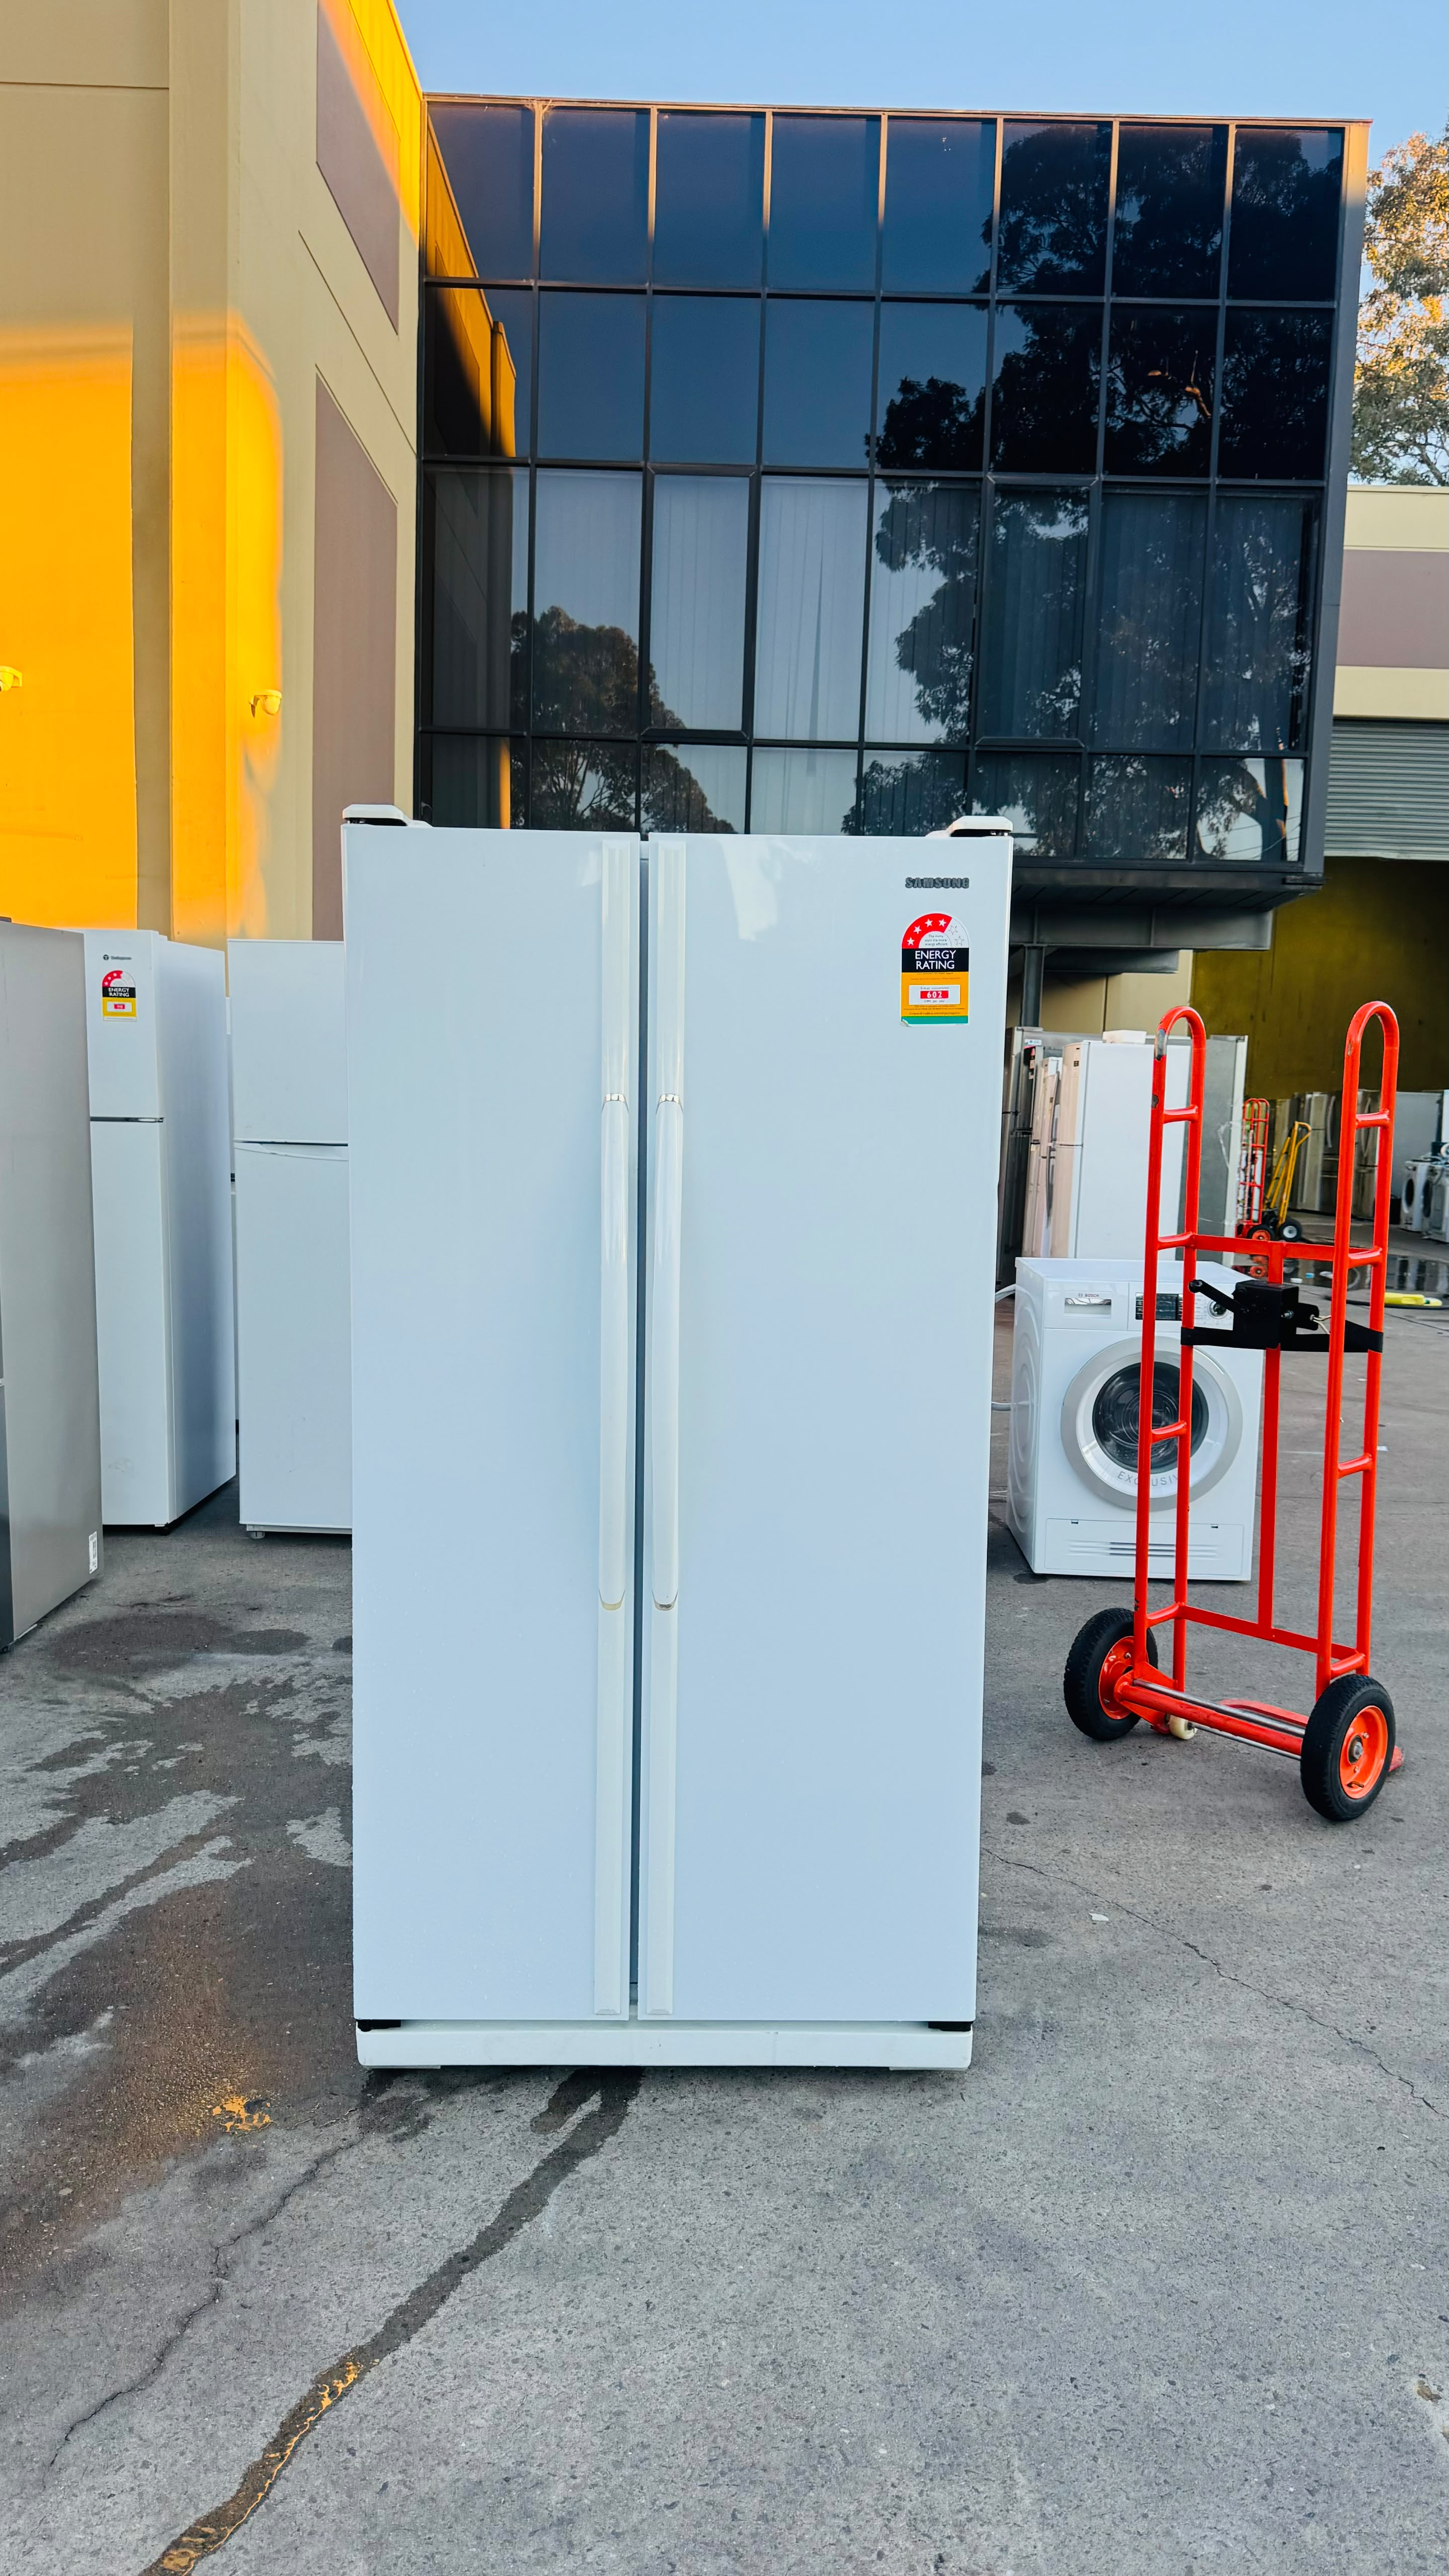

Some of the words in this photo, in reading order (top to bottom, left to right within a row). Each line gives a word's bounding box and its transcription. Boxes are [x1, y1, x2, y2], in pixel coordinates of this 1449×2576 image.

[905, 877, 970, 889] SAMSUNG
[915, 950, 956, 959] ENERGY
[916, 960, 955, 970] RATING
